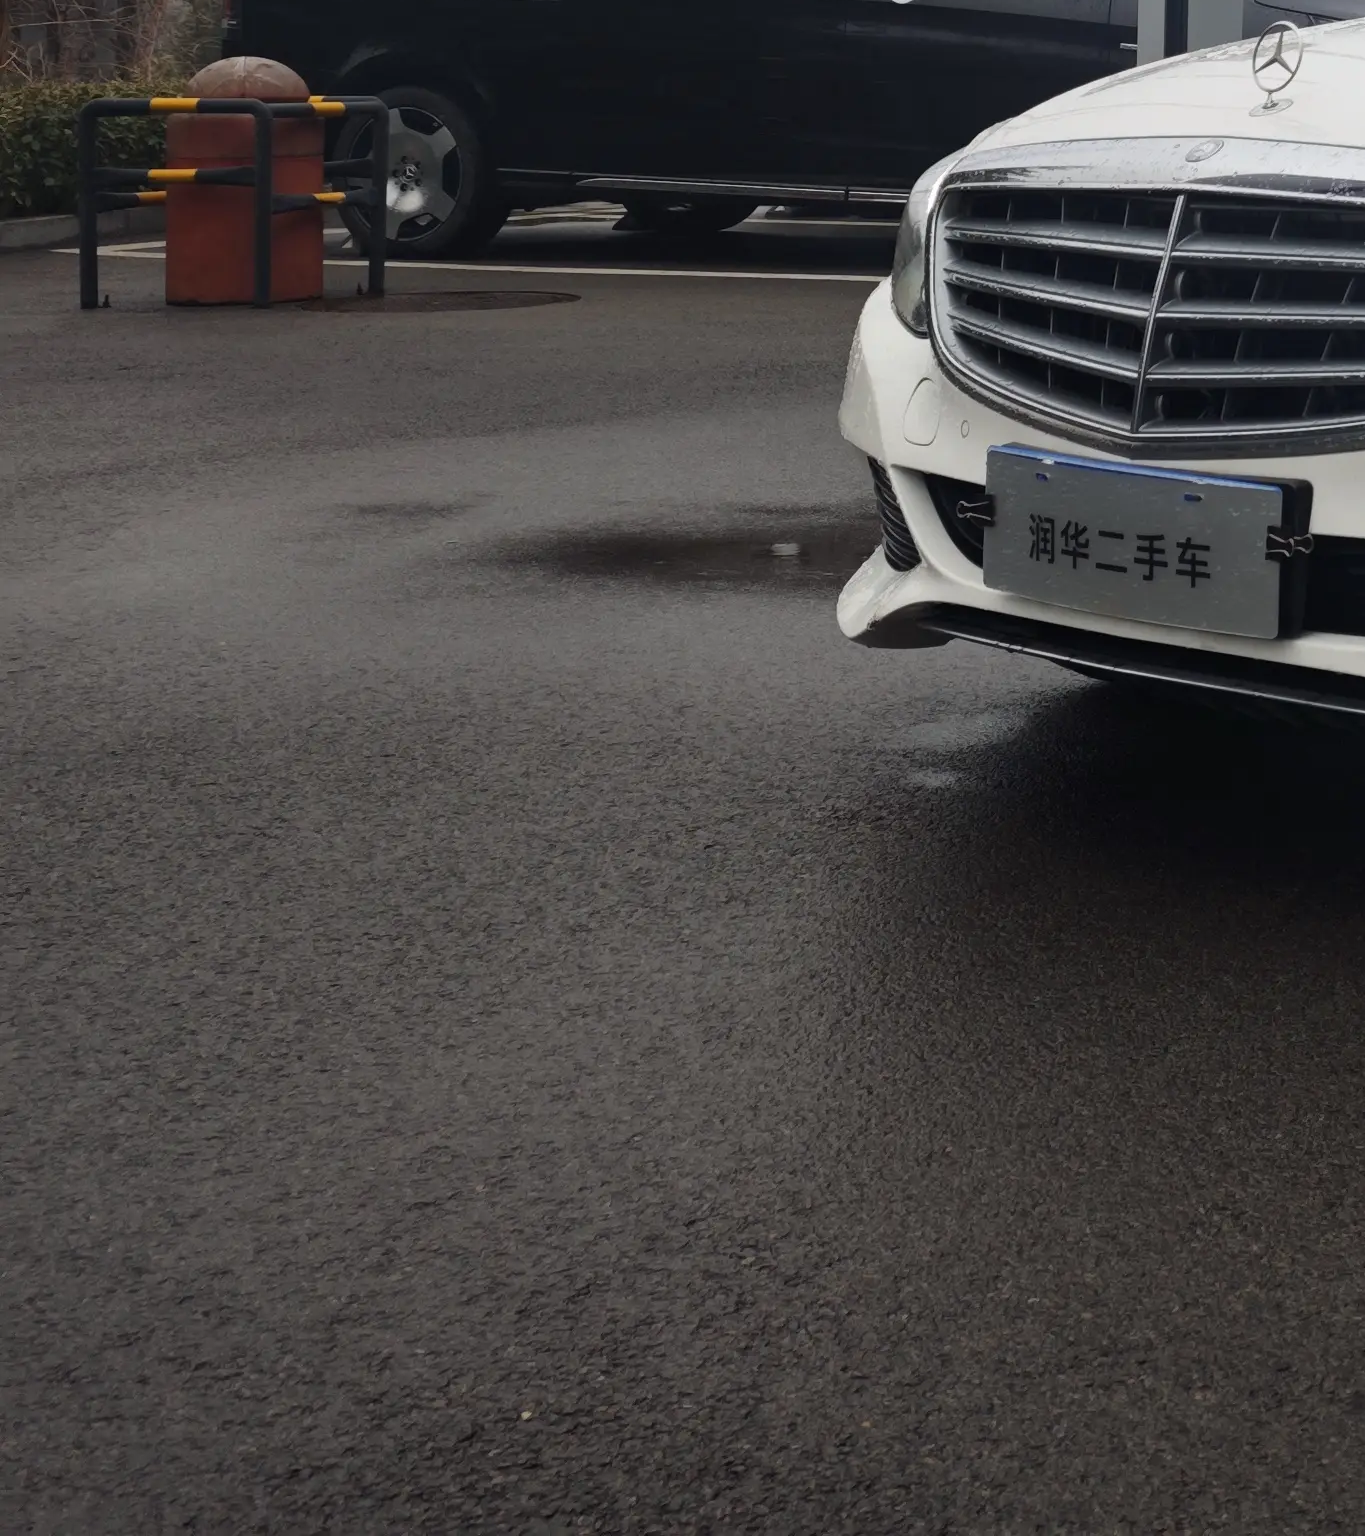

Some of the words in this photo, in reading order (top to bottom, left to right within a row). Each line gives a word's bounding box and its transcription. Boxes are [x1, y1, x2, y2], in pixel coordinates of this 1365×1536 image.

[1028, 514, 1211, 588] 润华二手车
